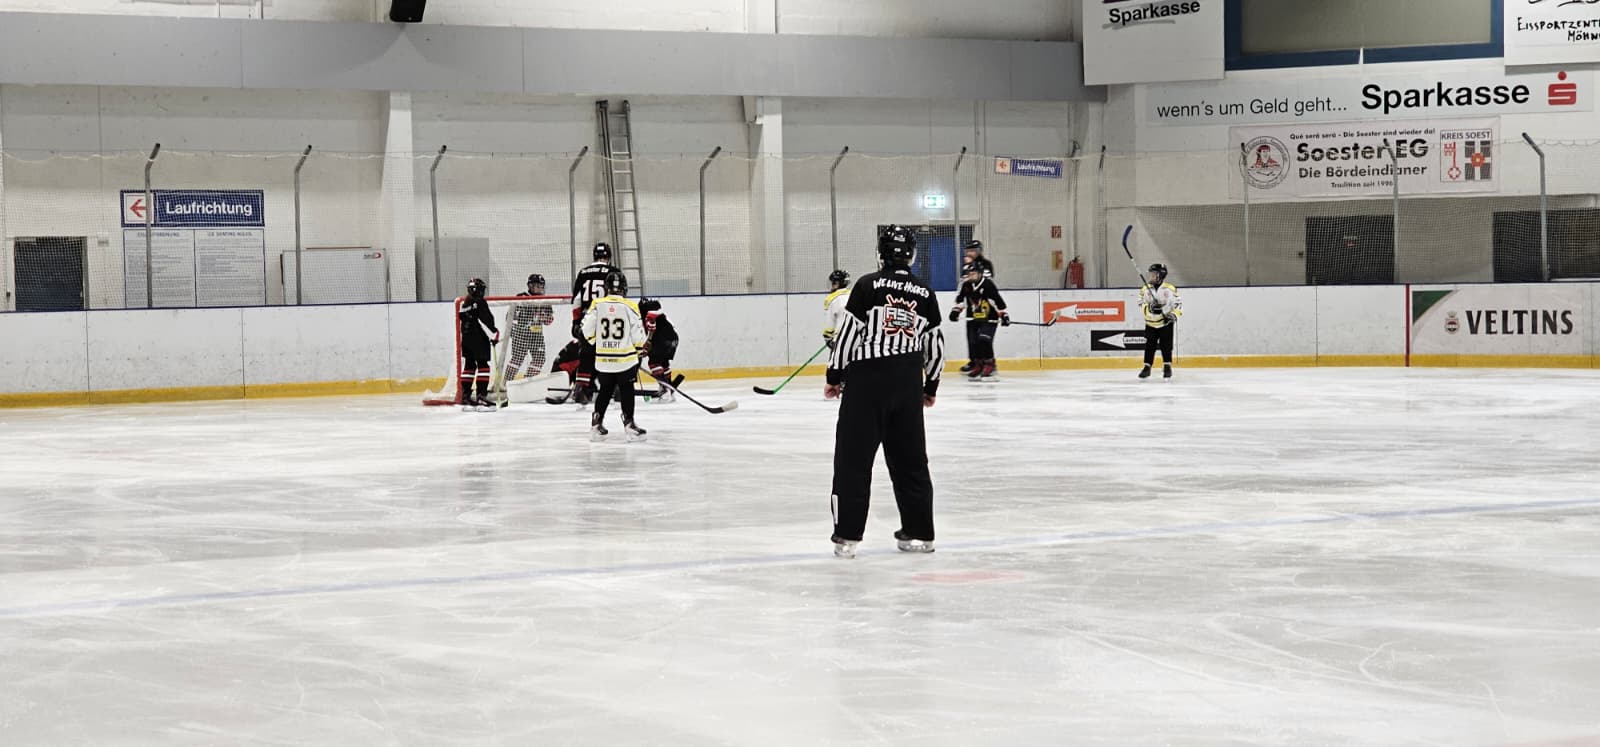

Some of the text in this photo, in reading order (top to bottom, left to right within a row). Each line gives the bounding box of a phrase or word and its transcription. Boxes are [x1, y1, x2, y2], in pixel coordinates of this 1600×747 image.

[1109, 1, 1201, 26] Sparkasse
[1517, 16, 1600, 31] EISSPORTZENT
[1568, 30, 1600, 42] MÖHN
[1219, 103, 1244, 116] um
[1250, 97, 1289, 114] Geld
[1361, 81, 1530, 115] Sparkasse
[1441, 131, 1490, 140] KREIS SOEST
[1297, 138, 1429, 162] Soester EG
[1298, 167, 1321, 178] Die
[165, 201, 253, 216] Laufrichtung
[582, 279, 606, 302] 15
[600, 317, 625, 340] 33
[1465, 309, 1574, 335] VELTINS
